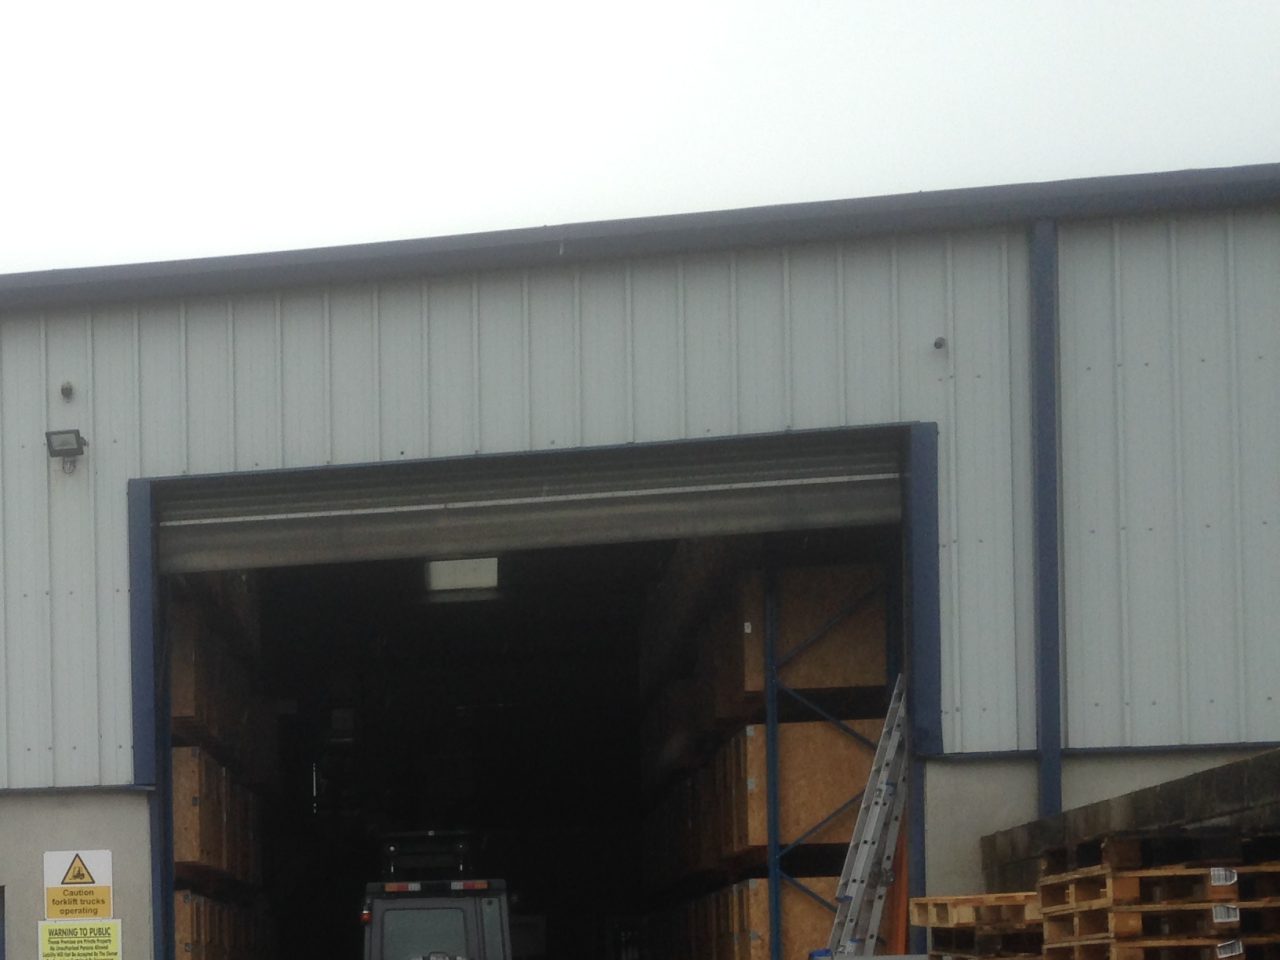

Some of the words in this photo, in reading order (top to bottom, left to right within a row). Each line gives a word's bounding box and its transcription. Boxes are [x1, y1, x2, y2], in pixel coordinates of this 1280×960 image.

[62, 888, 94, 896] Caution
[59, 907, 98, 916] operating
[48, 928, 78, 936] WARNING
[80, 928, 88, 936] TO
[90, 926, 111, 936] PUBLIC
